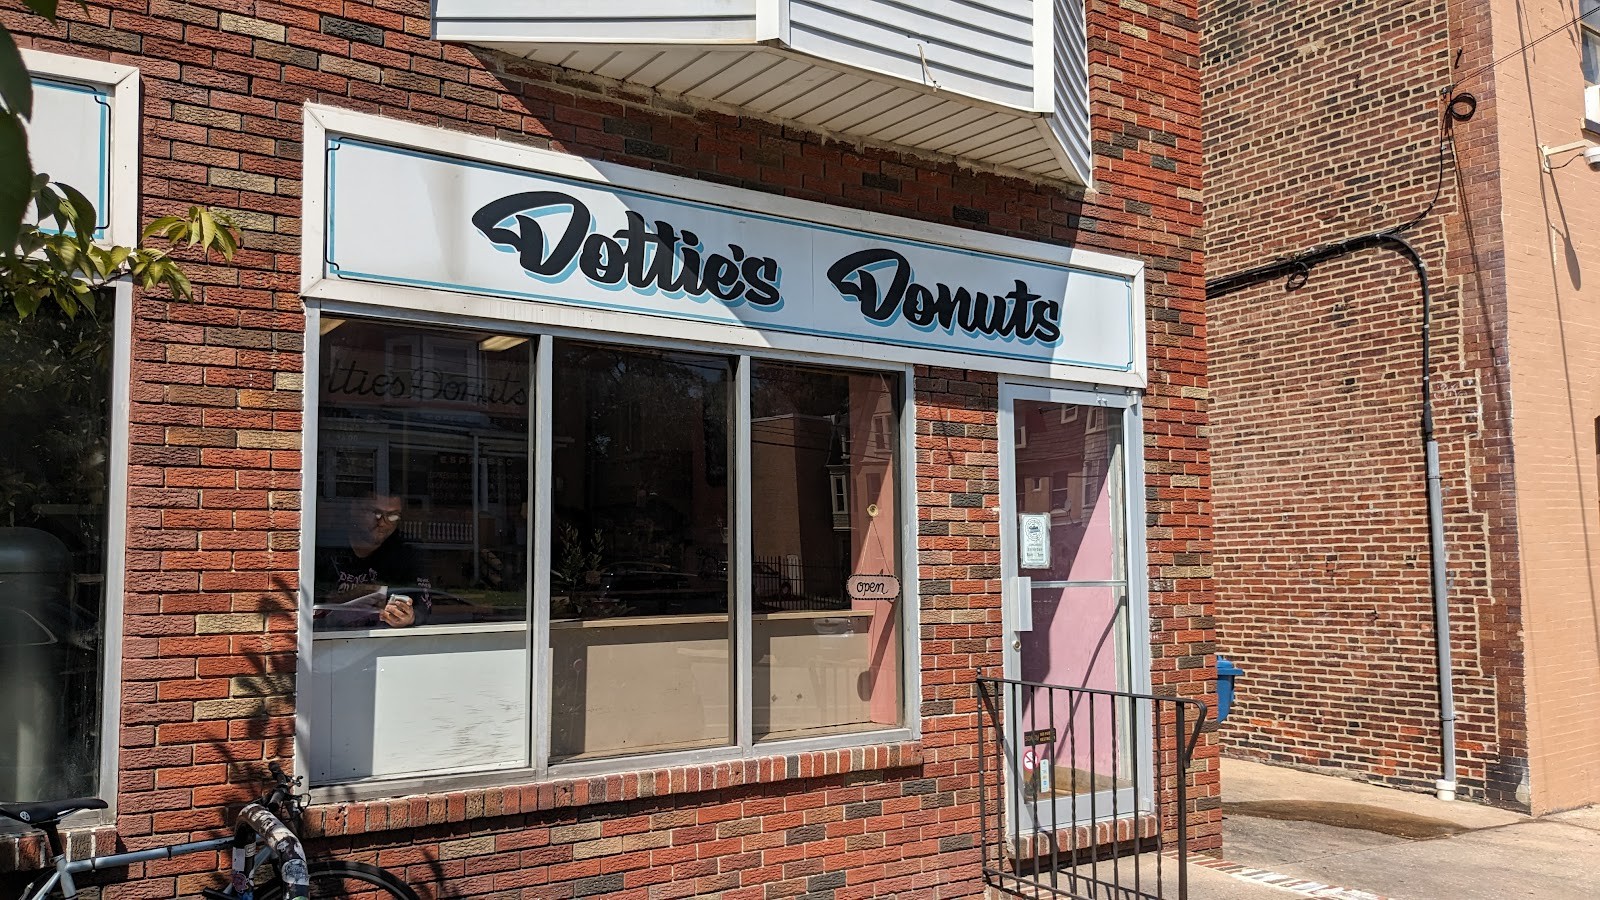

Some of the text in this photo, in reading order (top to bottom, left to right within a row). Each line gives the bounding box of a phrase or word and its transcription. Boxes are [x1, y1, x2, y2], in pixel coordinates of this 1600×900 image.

[471, 190, 1062, 345] Dottie's Donuts
[322, 360, 405, 397] tties
[856, 581, 889, 596] open
